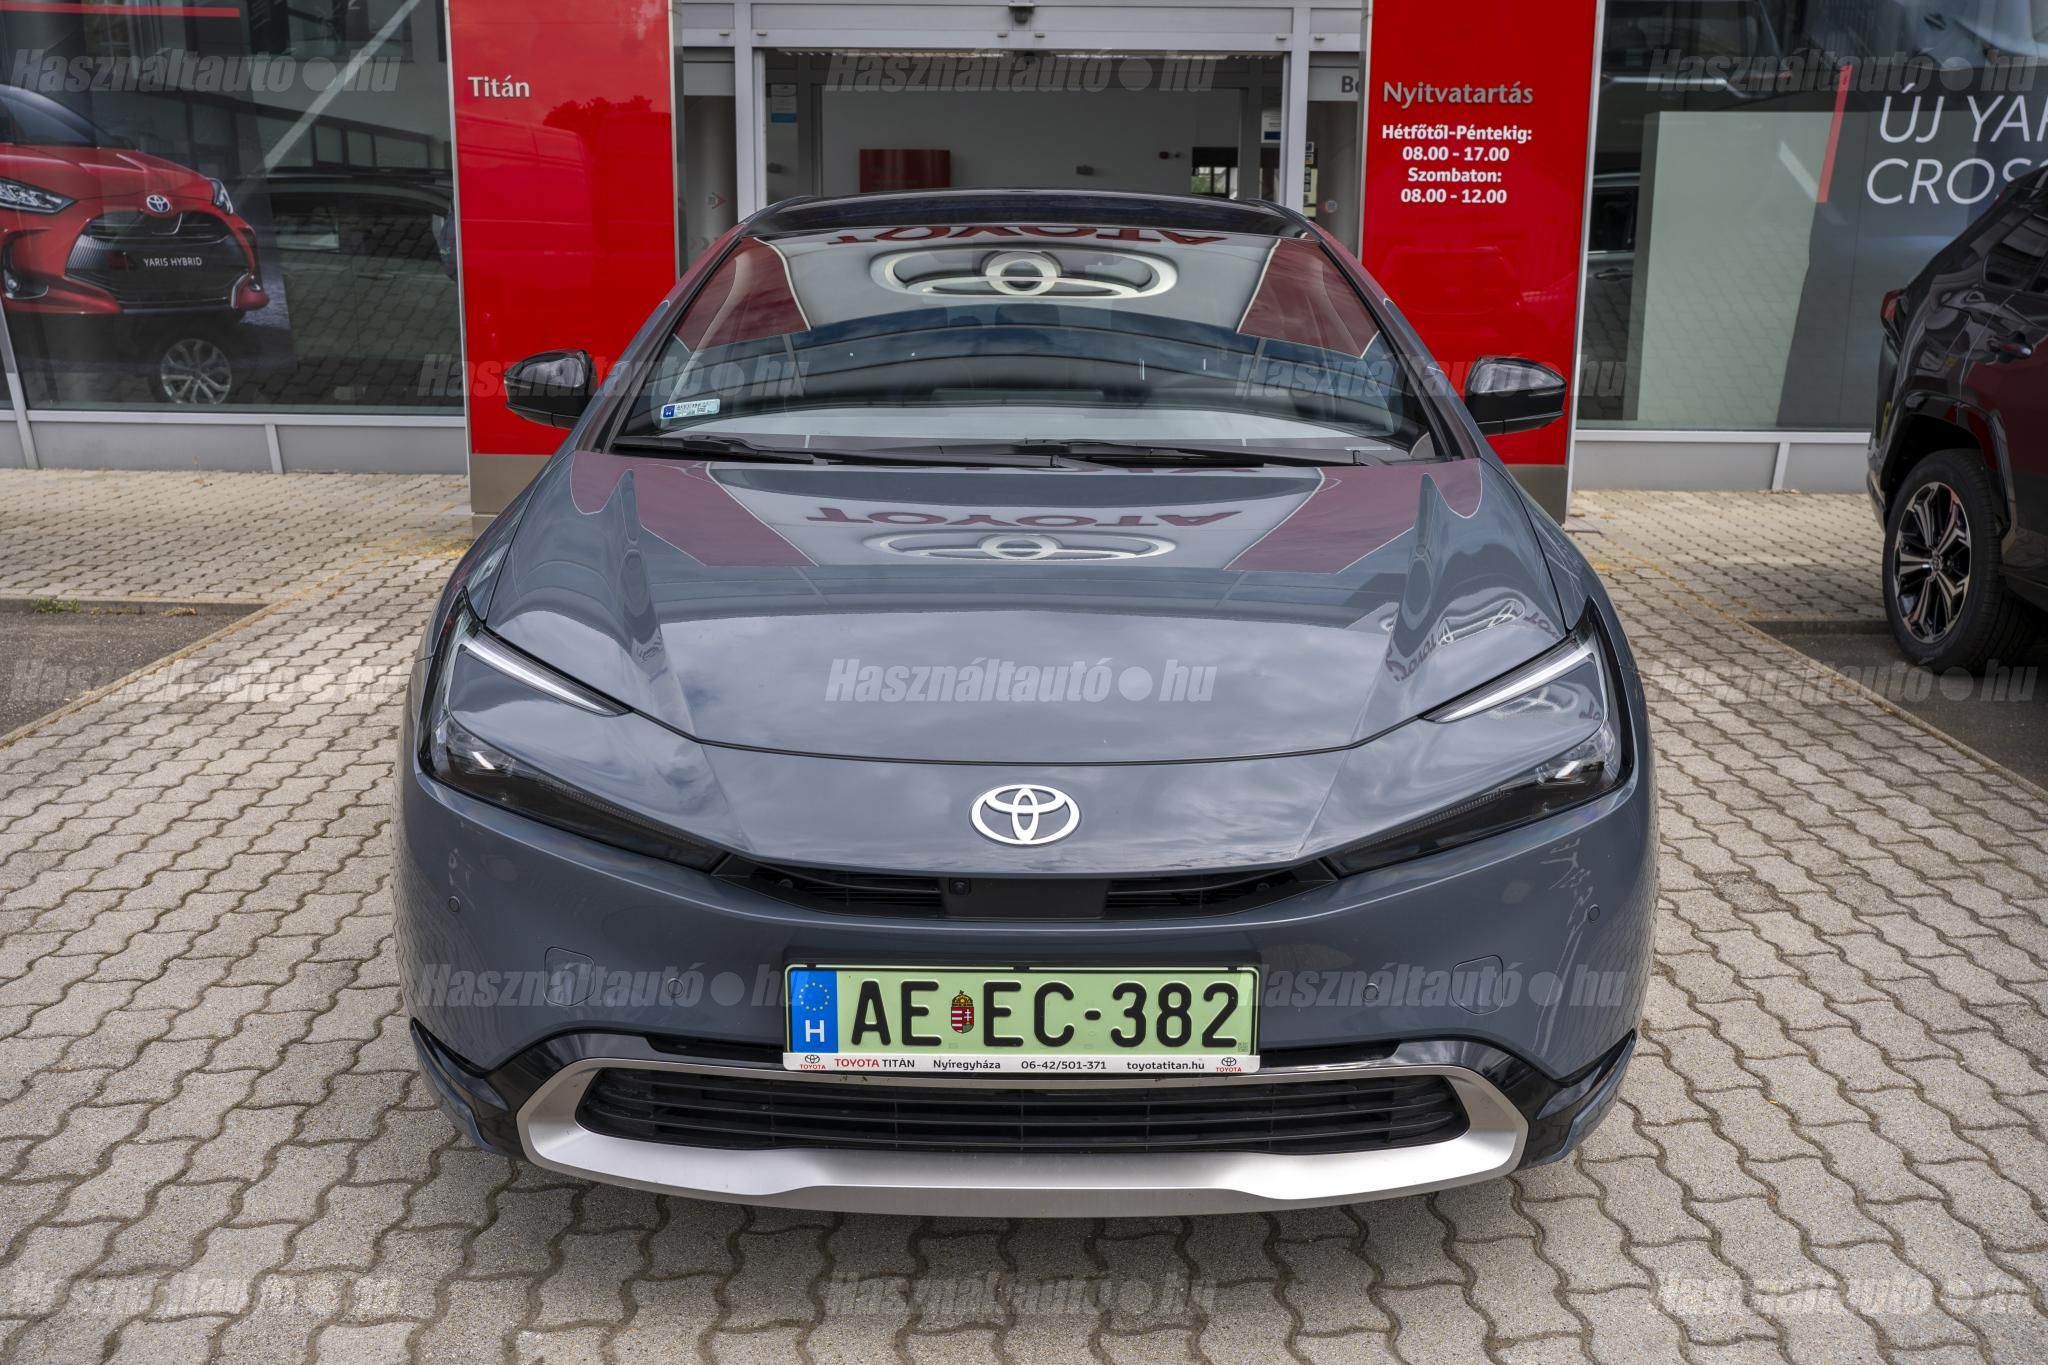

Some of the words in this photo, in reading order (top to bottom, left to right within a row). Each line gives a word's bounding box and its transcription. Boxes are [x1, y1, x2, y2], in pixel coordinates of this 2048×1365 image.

[468, 75, 530, 97] Titán
[1341, 76, 1360, 93] B
[1383, 80, 1533, 109] Nyitvatartás
[1880, 82, 1945, 143] ÚJ
[1382, 124, 1532, 144] Hétfőtől-Péntekig:
[1402, 146, 1449, 161] 08.00
[1463, 147, 1510, 161] 17.00
[1408, 167, 1502, 183] Szombaton:
[1401, 188, 1447, 203] 08.00
[1461, 189, 1507, 204] 12.00
[143, 257, 168, 267] YARIS
[170, 256, 202, 266] HYBRID
[851, 980, 942, 1046] AE
[983, 981, 1240, 1048] EC-382
[805, 1019, 825, 1043] H
[834, 1058, 880, 1067] TOYOTA
[934, 1059, 1001, 1071] Nyíregyháza
[1021, 1061, 1107, 1070] 06-42/501-371
[1127, 1061, 1205, 1071] toyotatitan.hu
